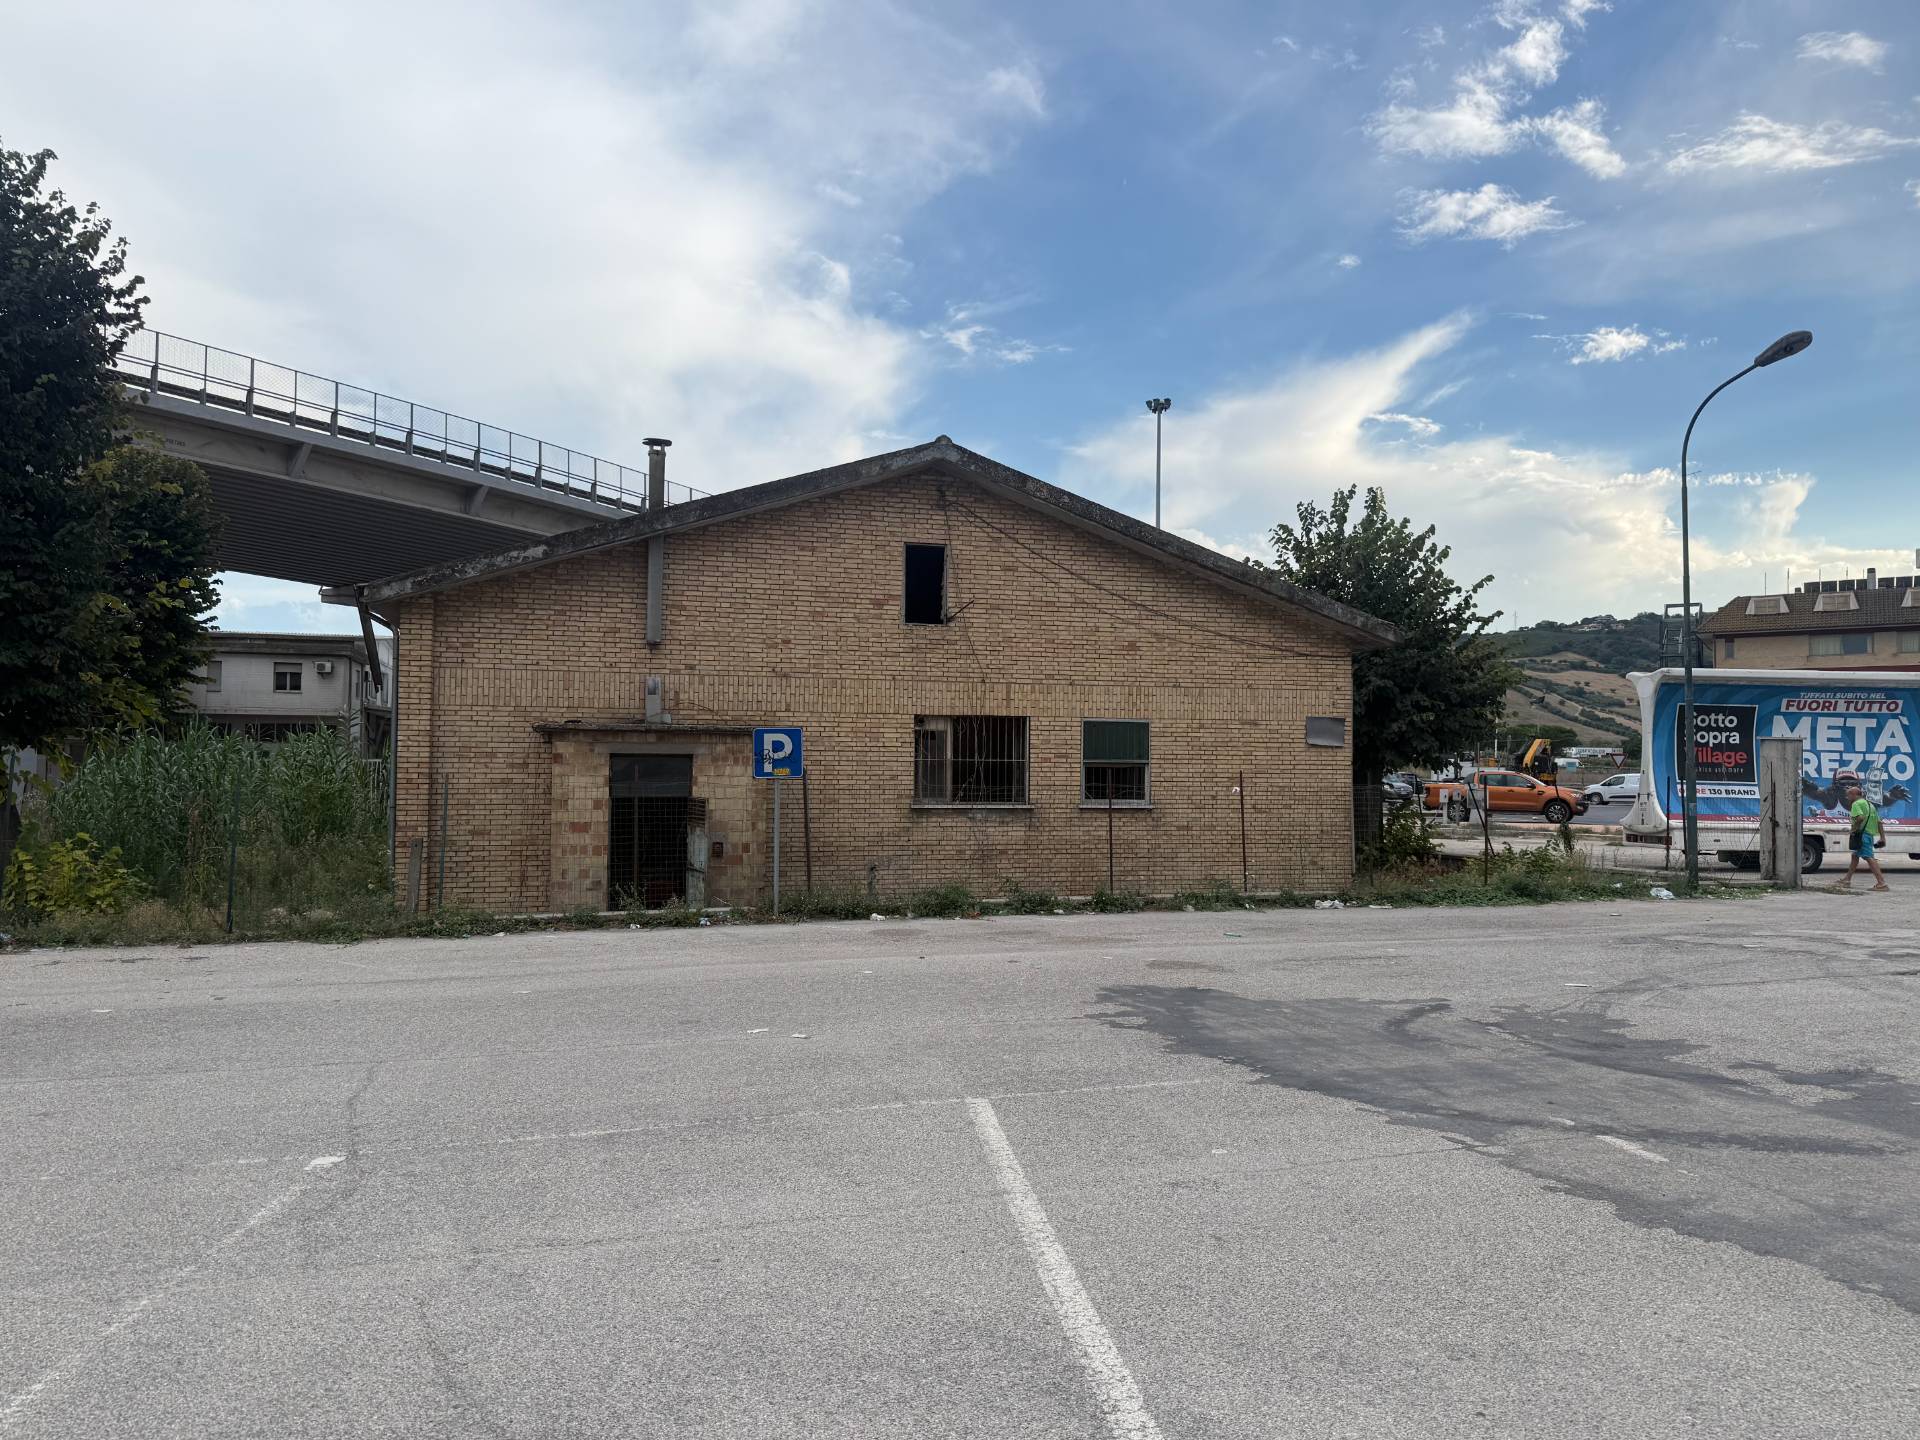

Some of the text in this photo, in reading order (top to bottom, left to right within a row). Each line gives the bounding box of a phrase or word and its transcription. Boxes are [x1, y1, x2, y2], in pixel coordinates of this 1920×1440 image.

[1785, 700, 1900, 712] FUORI TUTTO
[1692, 711, 1738, 728] otto
[1771, 715, 1912, 753] METÀ
[763, 733, 793, 772] P
[1724, 788, 1756, 796] BRAND
